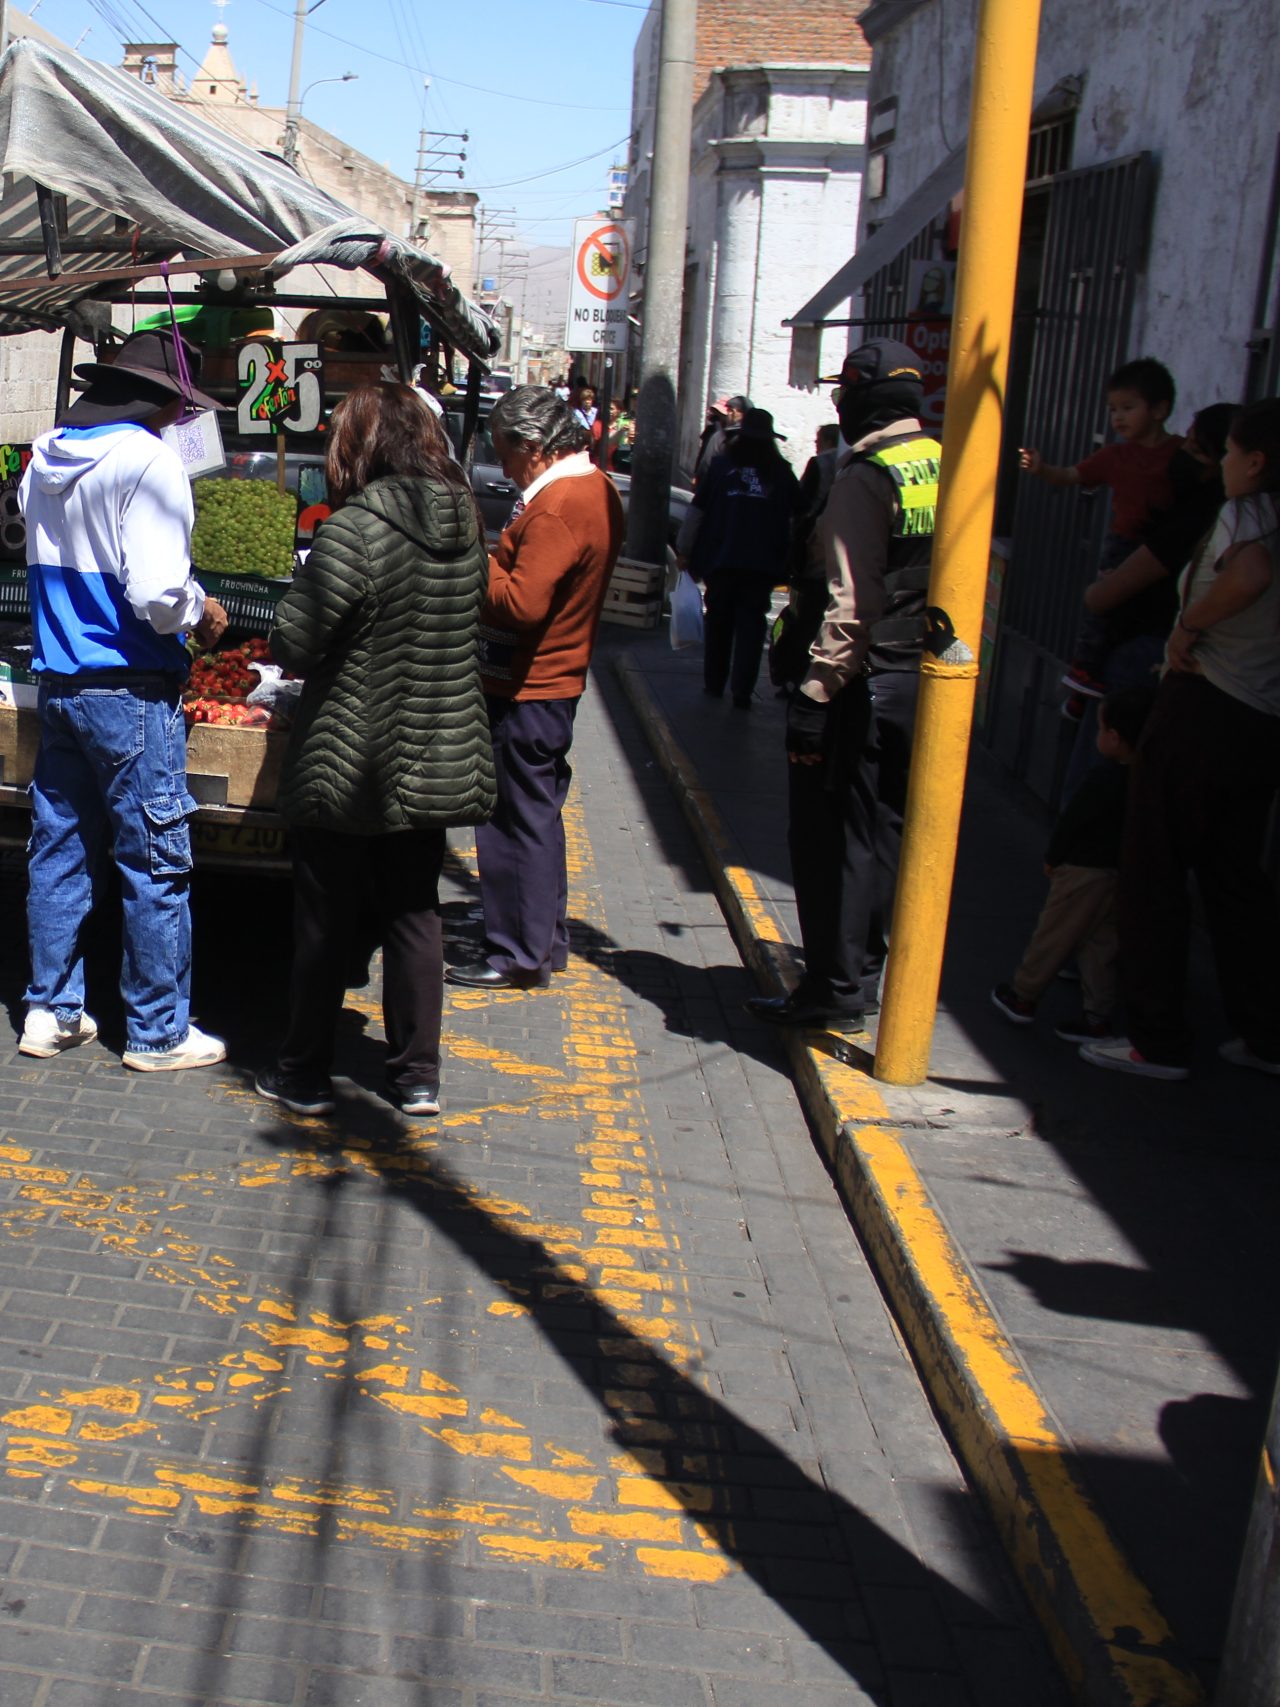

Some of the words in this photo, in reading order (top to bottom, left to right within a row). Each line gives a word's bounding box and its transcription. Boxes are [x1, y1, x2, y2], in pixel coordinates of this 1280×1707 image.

[574, 308, 589, 322] NO
[592, 330, 616, 344] CRUCE
[220, 578, 269, 595] FRUCHINCHA
